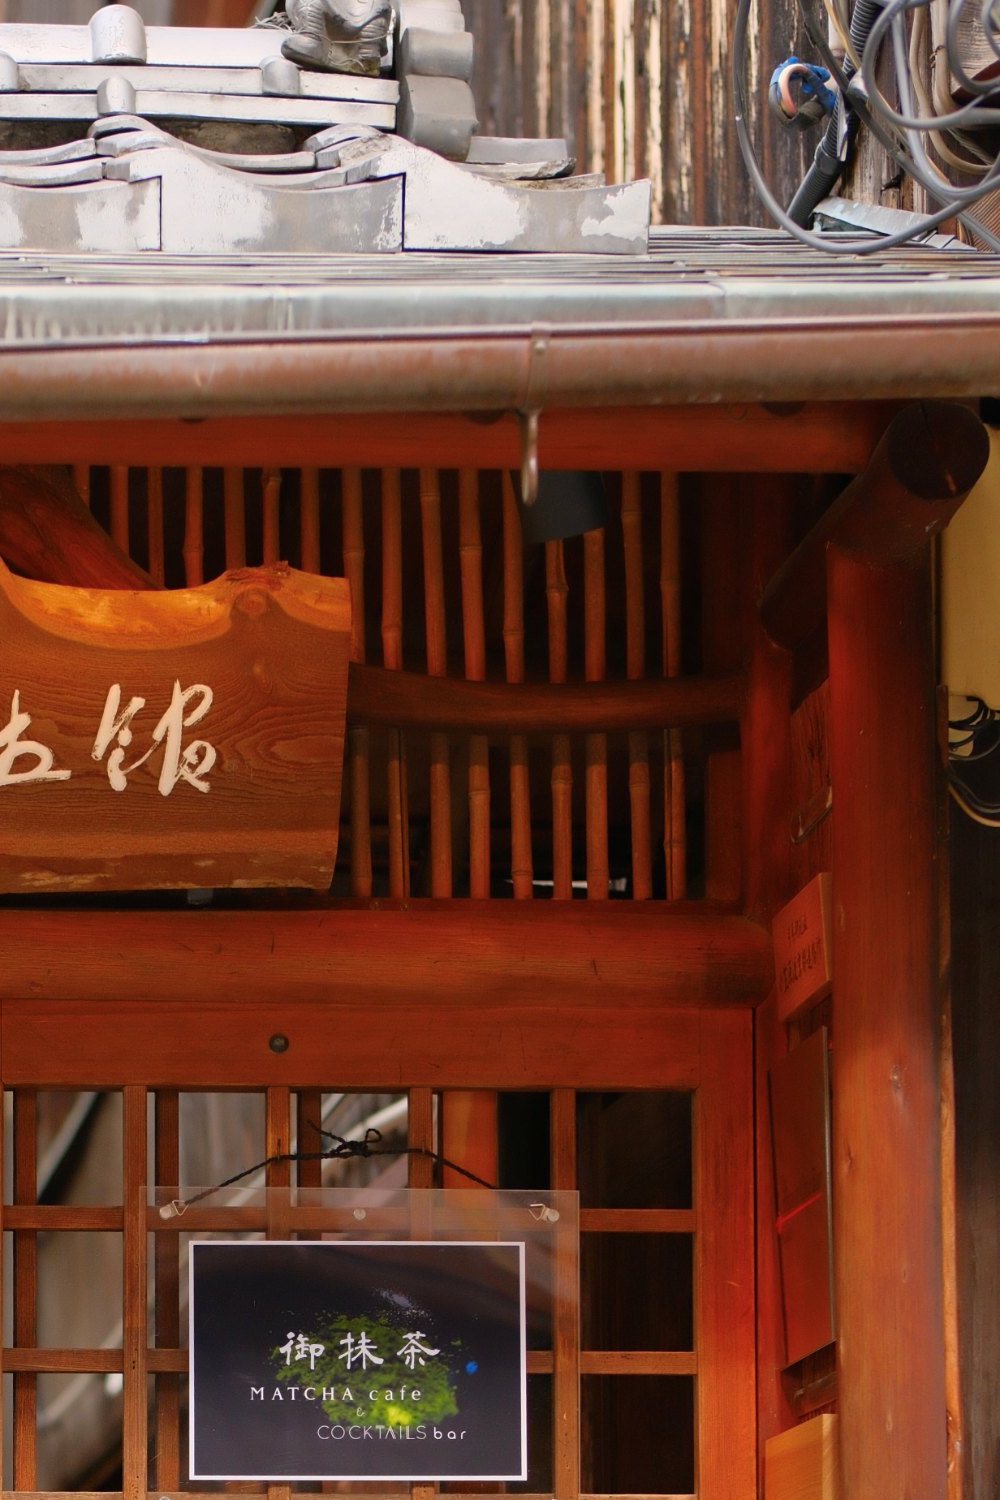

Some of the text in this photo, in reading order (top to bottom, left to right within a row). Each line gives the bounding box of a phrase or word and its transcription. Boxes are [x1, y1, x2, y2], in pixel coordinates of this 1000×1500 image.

[279, 1331, 440, 1371] 御抹茶
[249, 1385, 422, 1401] MATCHA cafe
[317, 1425, 467, 1440] COCKTAILS bar
